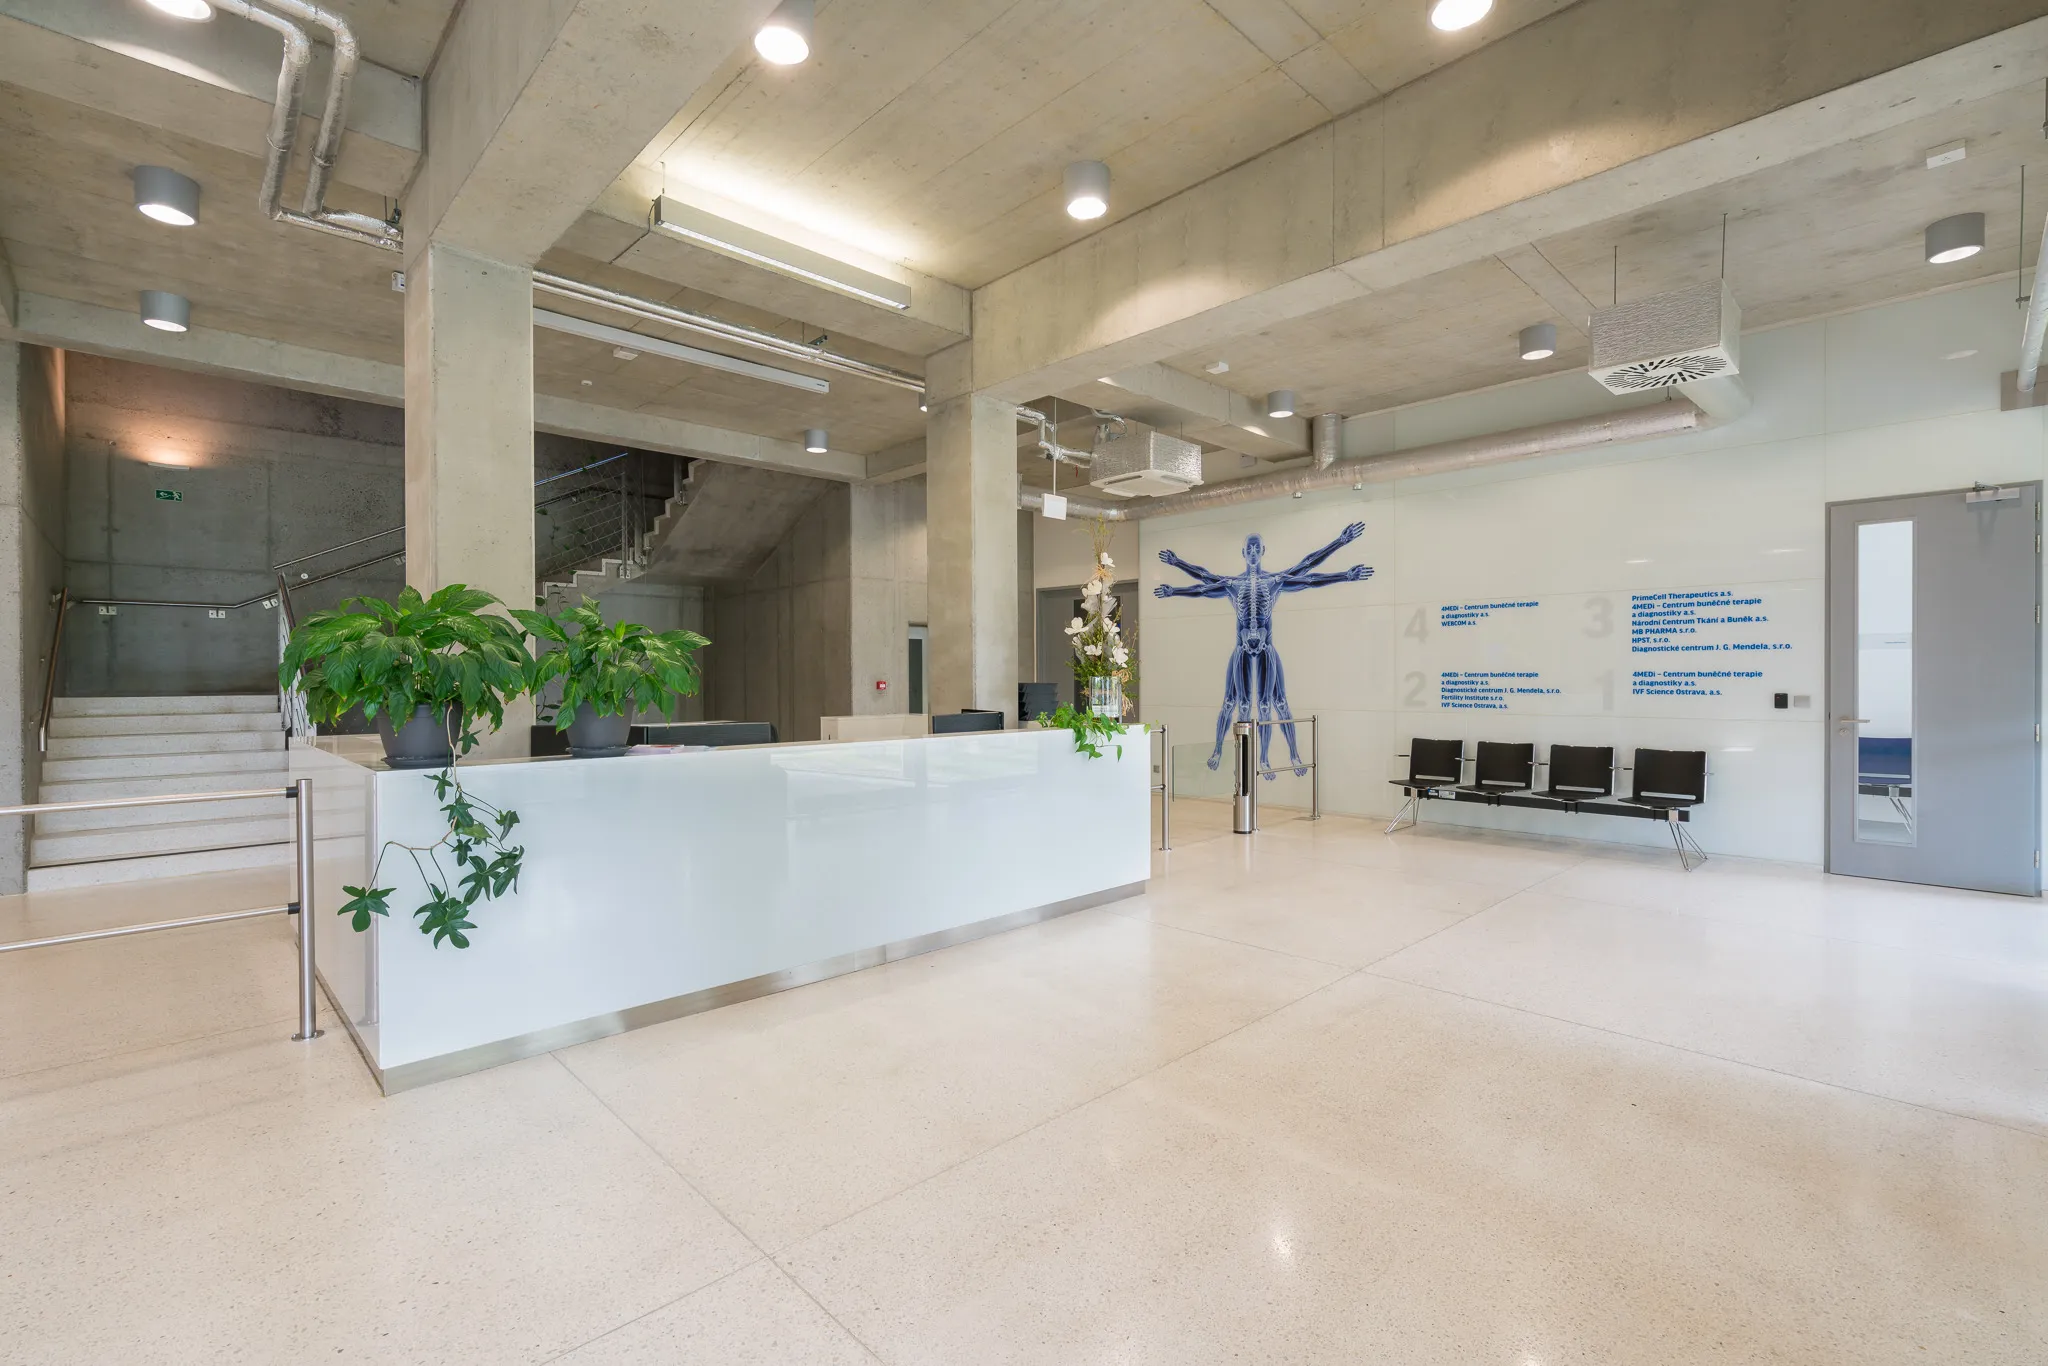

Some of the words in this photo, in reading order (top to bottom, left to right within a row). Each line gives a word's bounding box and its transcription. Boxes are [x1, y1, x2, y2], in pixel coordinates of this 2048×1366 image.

[1632, 593, 1667, 601] PrimeCell
[1668, 592, 1718, 600] Therapeutics
[1662, 601, 1695, 609] Centrum
[1697, 599, 1730, 607] buněčné
[1732, 598, 1762, 606] terapie
[1583, 597, 1614, 639] 3
[1638, 610, 1682, 618] diagnostiky
[1404, 606, 1429, 645] 4
[1632, 618, 1661, 626] Národní
[1697, 616, 1718, 624] Tkání
[1727, 615, 1753, 623] Buněk
[1632, 644, 1679, 653] Diagnostické
[1697, 670, 1731, 678] buněčné
[1733, 671, 1763, 679] terapie
[1404, 671, 1428, 707] 2
[1638, 680, 1682, 688] diagnostiky
[1595, 669, 1614, 711] 1
